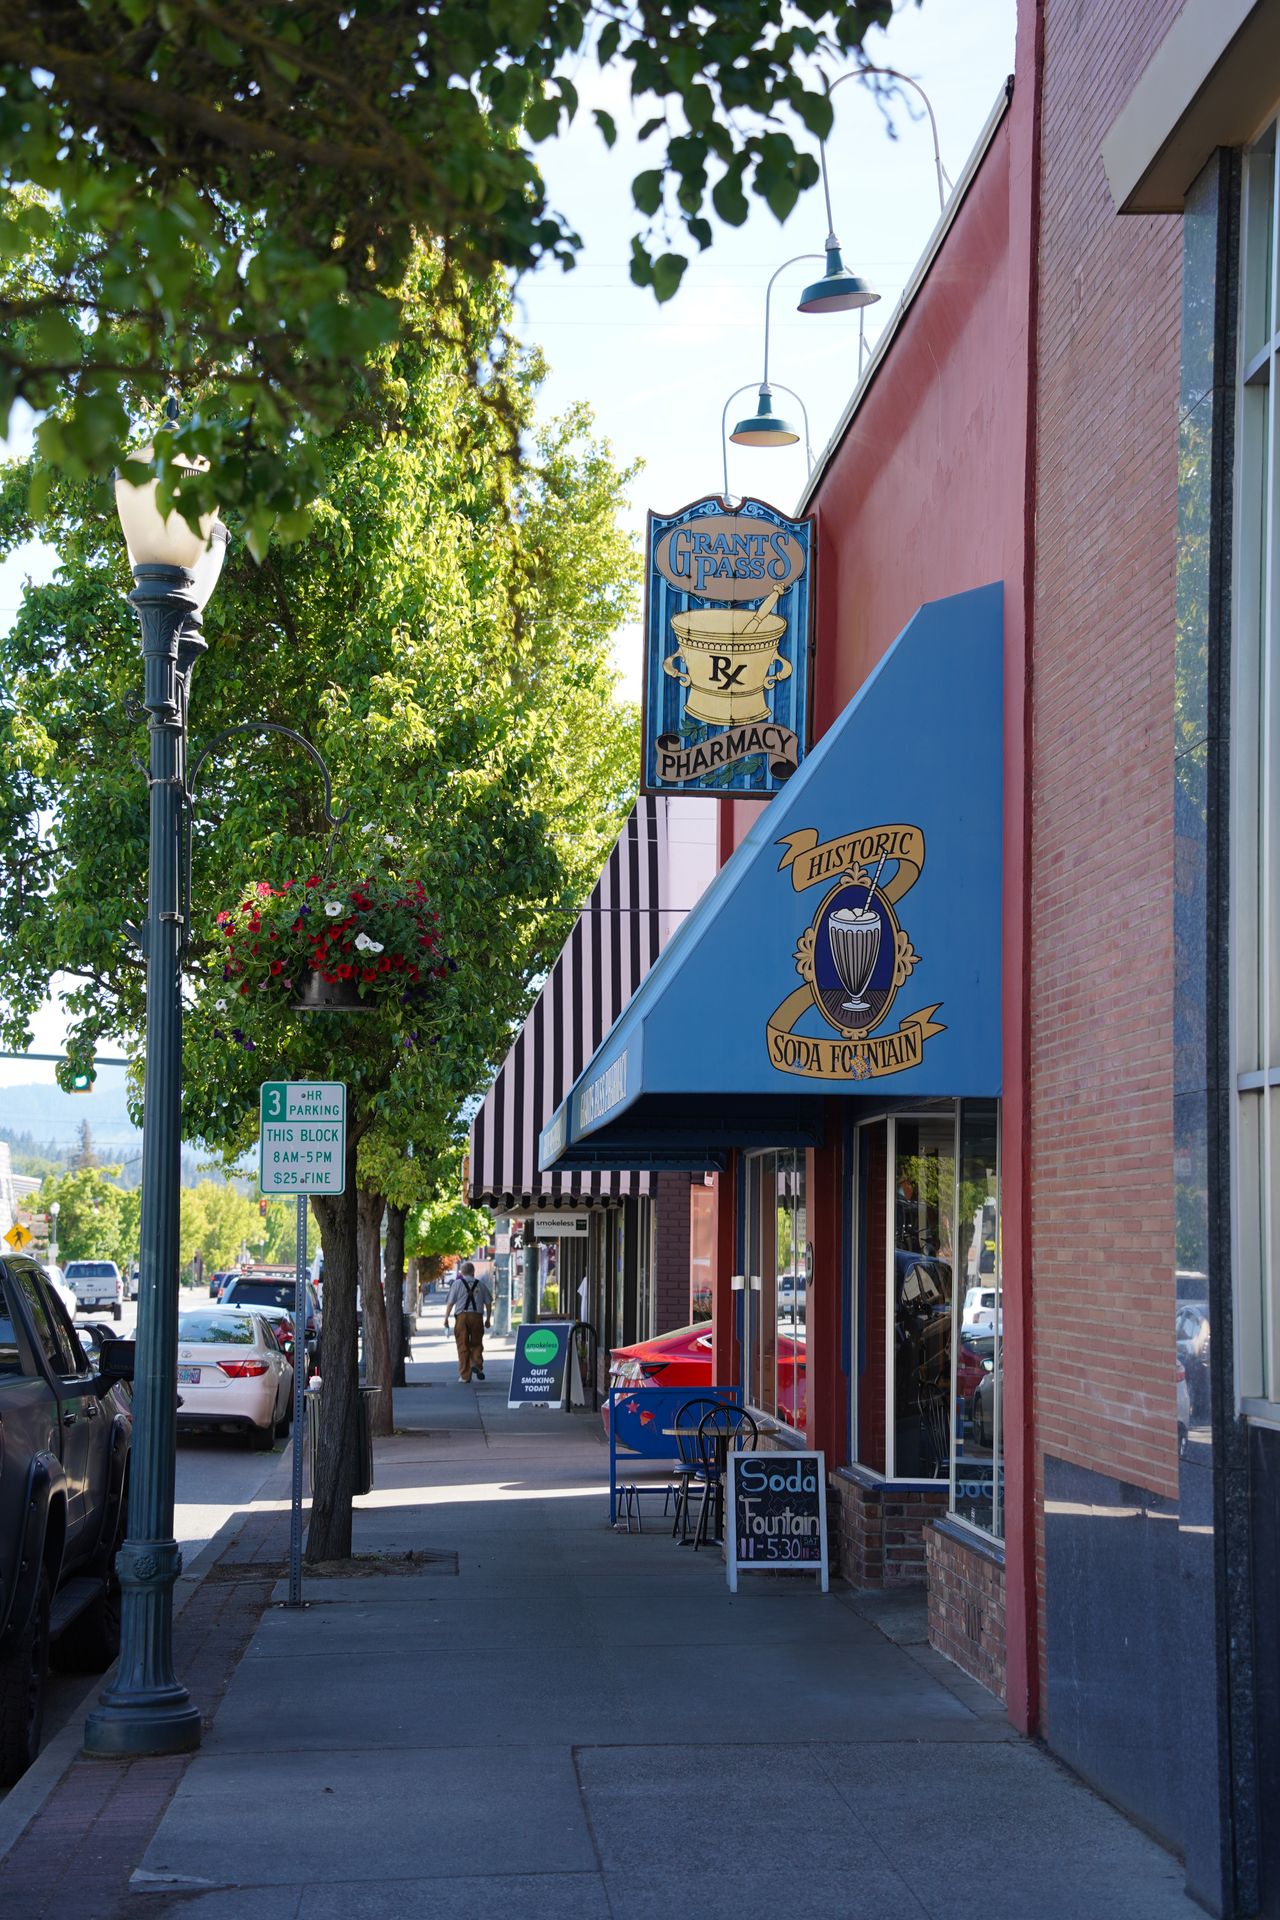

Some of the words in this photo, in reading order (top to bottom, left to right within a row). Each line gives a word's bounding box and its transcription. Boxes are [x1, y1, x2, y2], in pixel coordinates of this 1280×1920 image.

[669, 528, 791, 580] GRANTS
[694, 555, 766, 591] PASS
[661, 725, 793, 779] PHARMACY
[806, 831, 914, 881] HISTORIC
[773, 1034, 824, 1073] SODA
[268, 1090, 281, 1116] 3
[306, 1090, 322, 1101] HR
[289, 1104, 340, 1116] PARKING
[266, 1129, 294, 1142] THIS
[300, 1128, 339, 1142] BLOCK
[273, 1171, 298, 1185] $25
[304, 1172, 331, 1184] FINE
[535, 1219, 575, 1227] smokeless
[526, 1340, 558, 1349] smokeless
[530, 1368, 548, 1376] QUIT
[740, 1458, 817, 1493] Soda
[738, 1494, 820, 1536] Fountain
[739, 1537, 801, 1560] 11-5:30
